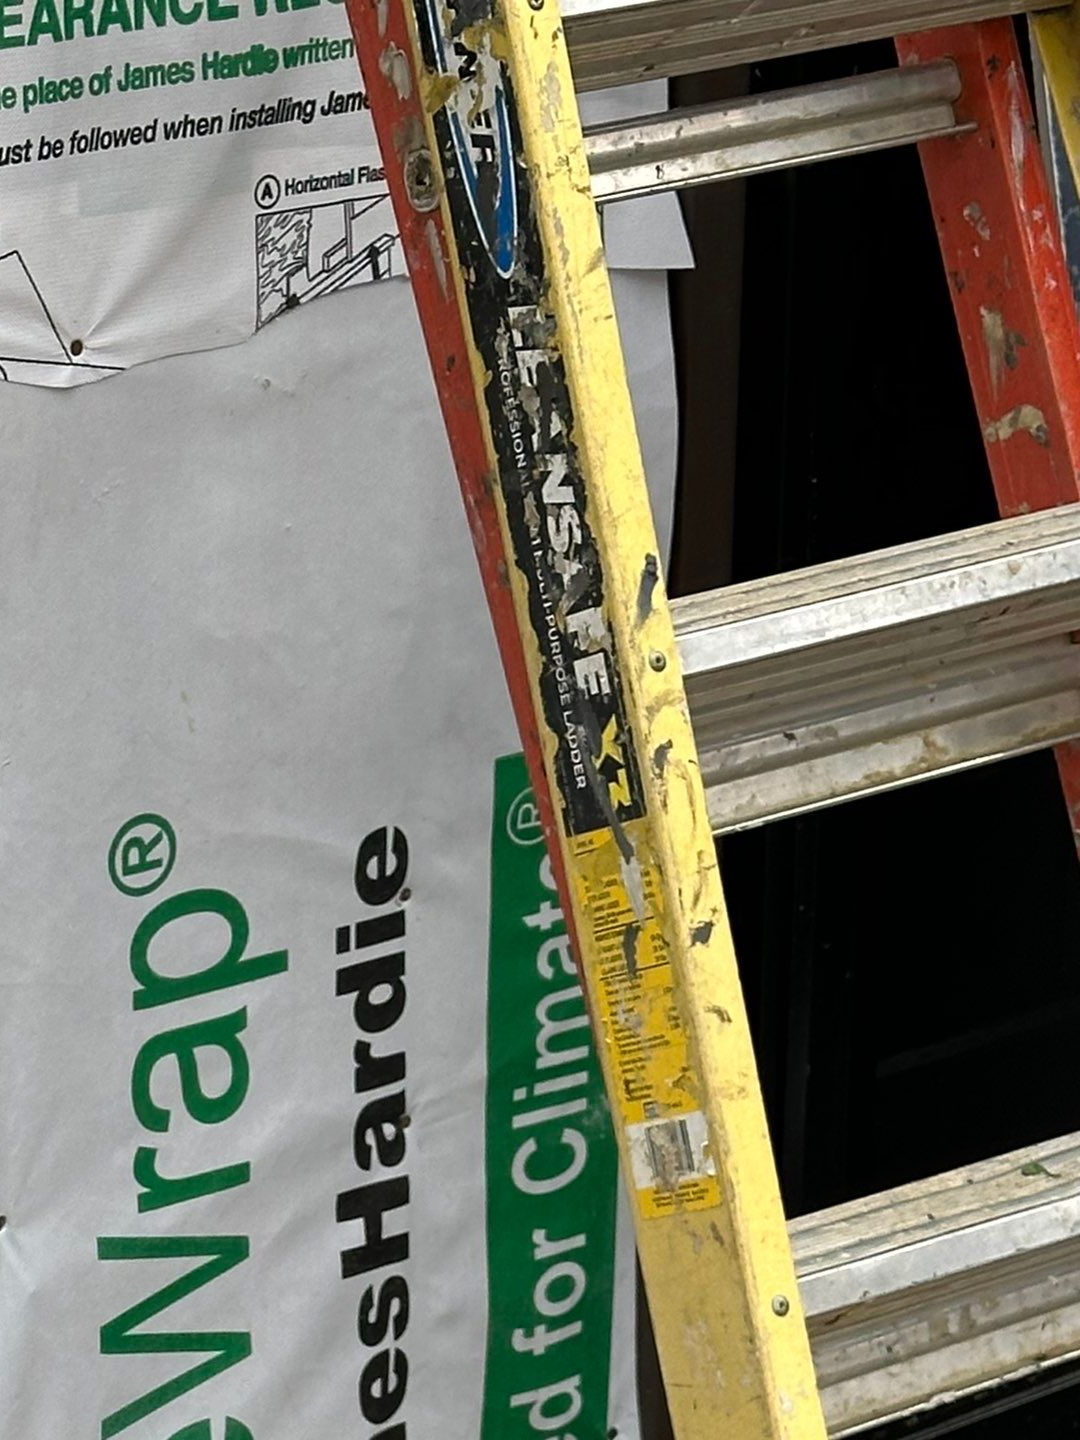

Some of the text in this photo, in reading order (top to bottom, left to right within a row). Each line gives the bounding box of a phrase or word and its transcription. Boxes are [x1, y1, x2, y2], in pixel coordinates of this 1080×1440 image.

[23, 76, 84, 113] place
[89, 65, 113, 96] of
[117, 59, 195, 92] James
[202, 44, 280, 81] Hardie
[282, 38, 355, 68] written
[38, 136, 64, 161] be
[69, 118, 159, 155] followed
[163, 114, 223, 141] when
[228, 97, 316, 132] installing
[285, 168, 355, 196] Horizontal
[563, 710, 586, 789] LADDER
[505, 786, 589, 1196] Climat®
[511, 1228, 586, 1356] for
